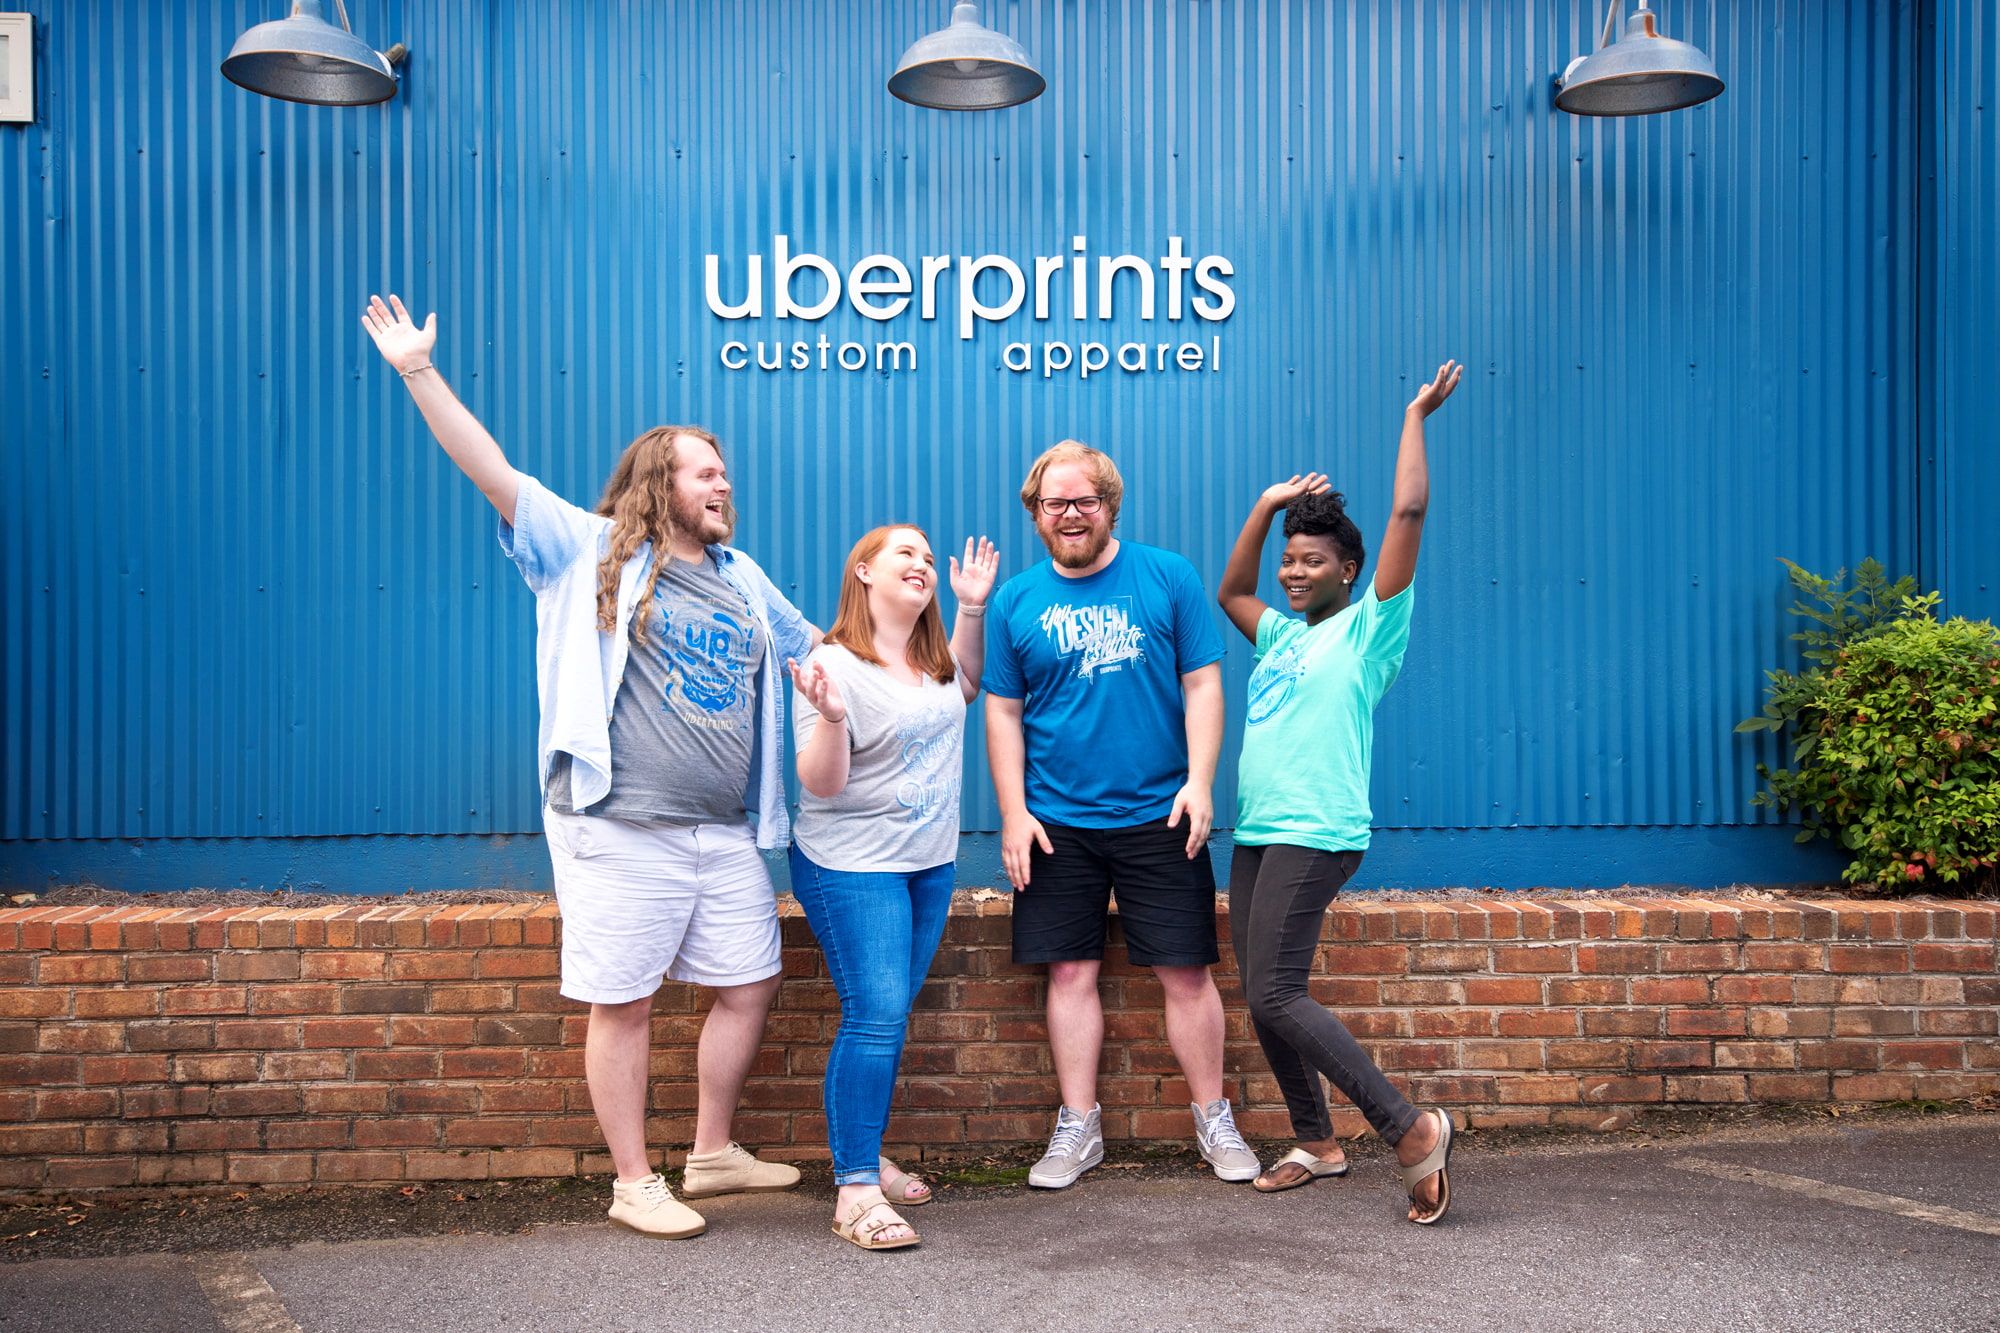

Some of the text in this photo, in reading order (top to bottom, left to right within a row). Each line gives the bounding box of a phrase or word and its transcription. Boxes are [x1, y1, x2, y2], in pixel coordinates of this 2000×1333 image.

[704, 234, 1236, 339] uberprints
[720, 333, 1221, 379] custom apparel
[684, 622, 731, 660] up
[1056, 604, 1128, 655] DESIGN
